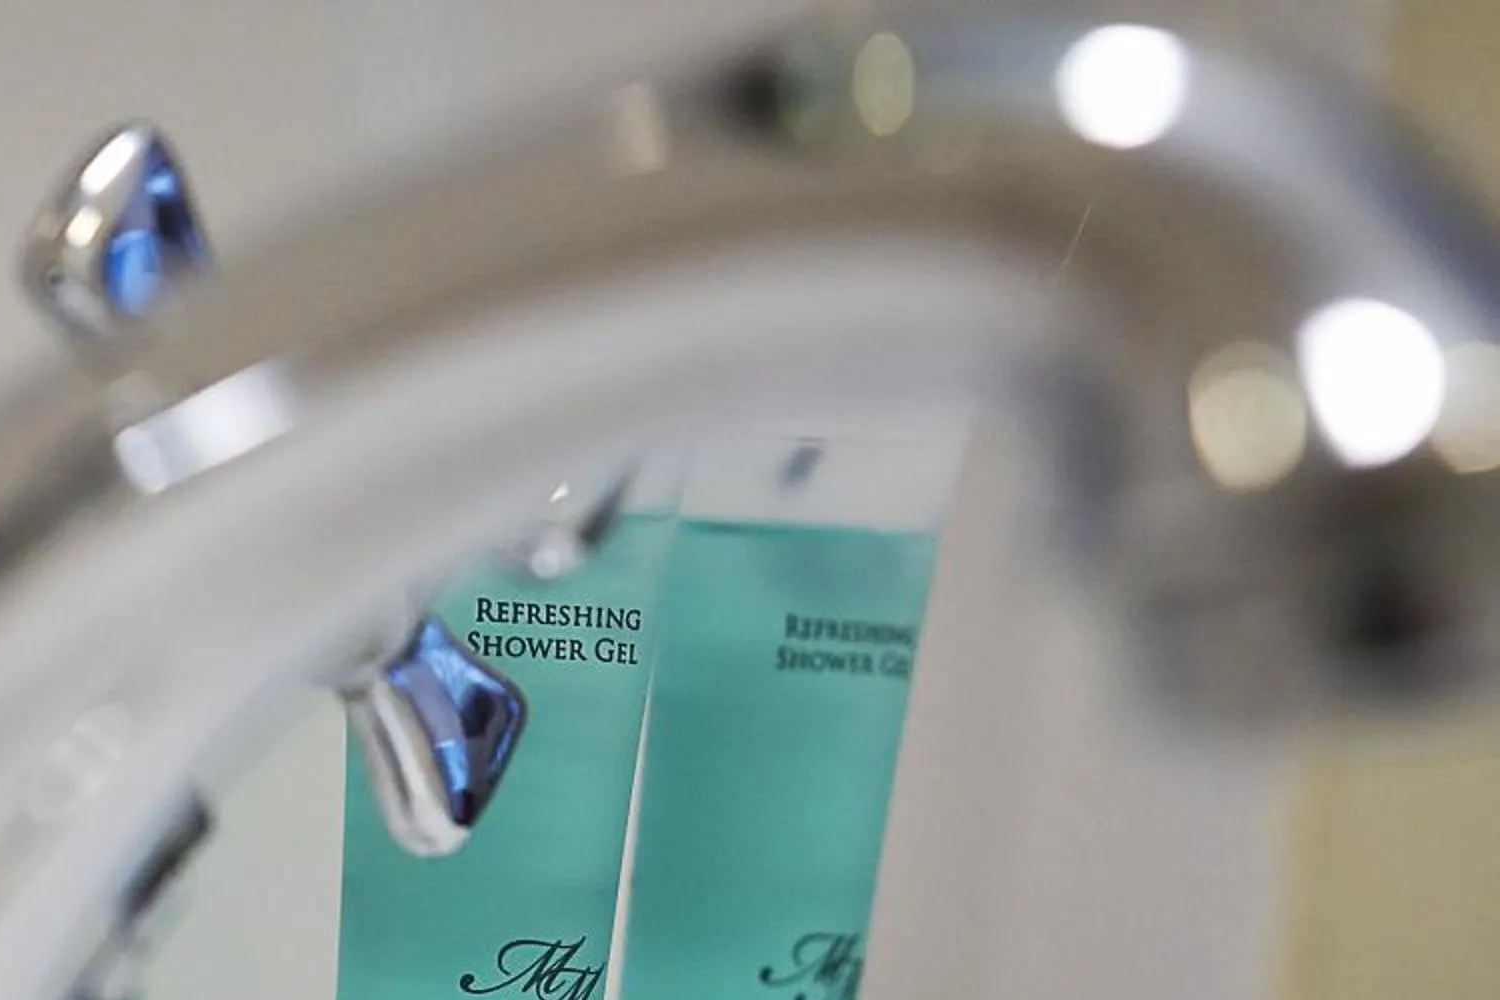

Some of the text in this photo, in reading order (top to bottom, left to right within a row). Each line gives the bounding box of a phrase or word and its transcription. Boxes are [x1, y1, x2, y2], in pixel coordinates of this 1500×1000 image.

[476, 597, 642, 631] REFRESHING
[467, 630, 638, 665] SHOWER GEL
[776, 645, 873, 673] SHOWER
